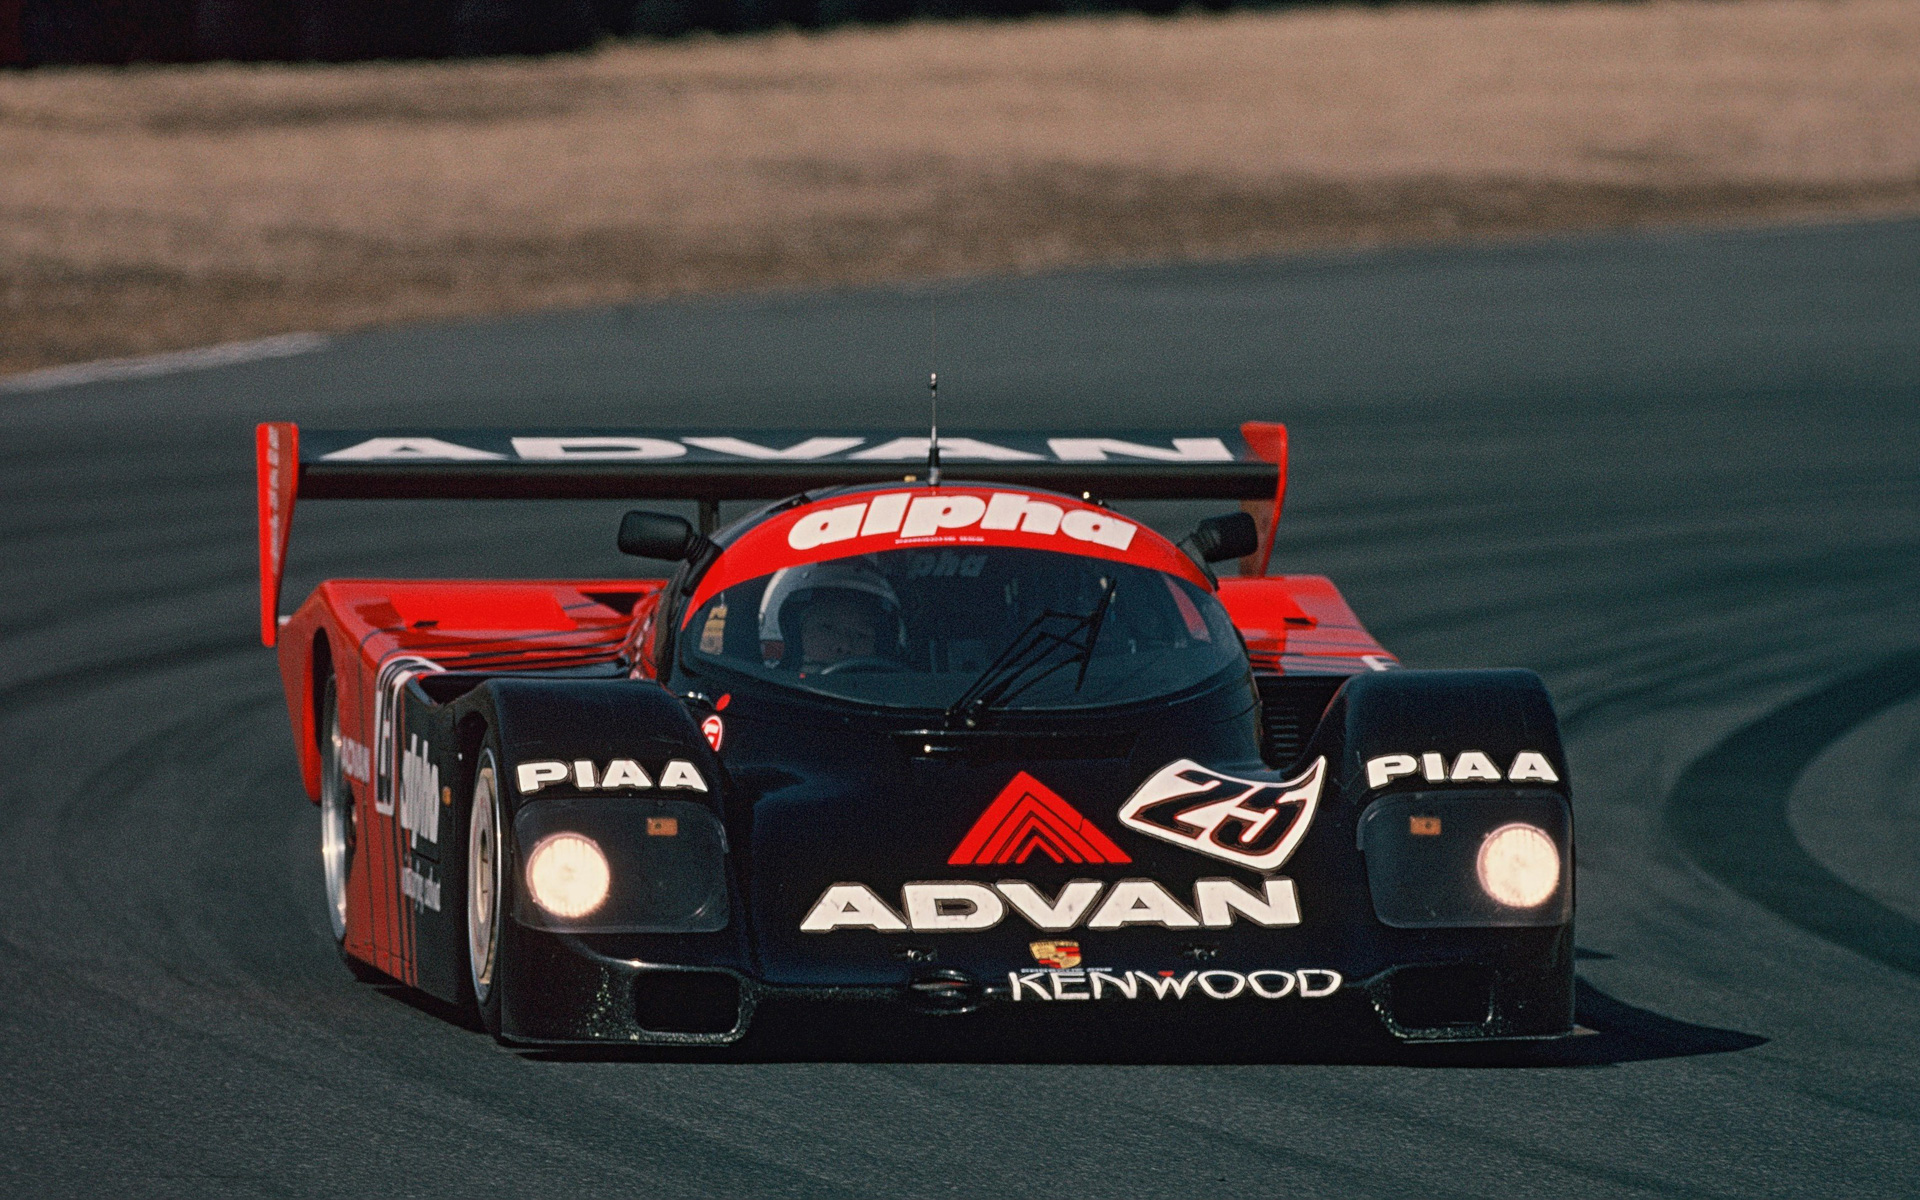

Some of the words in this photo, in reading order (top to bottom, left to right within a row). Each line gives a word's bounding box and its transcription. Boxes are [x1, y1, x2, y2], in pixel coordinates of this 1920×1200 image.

[319, 437, 1235, 461] ADVAN
[787, 492, 1137, 551] alpha
[517, 760, 709, 794] PIAA
[1367, 751, 1559, 789] PIAA
[1128, 767, 1320, 856] 25
[800, 879, 1302, 932] ADVAN
[1008, 968, 1343, 1002] KENWOOD
